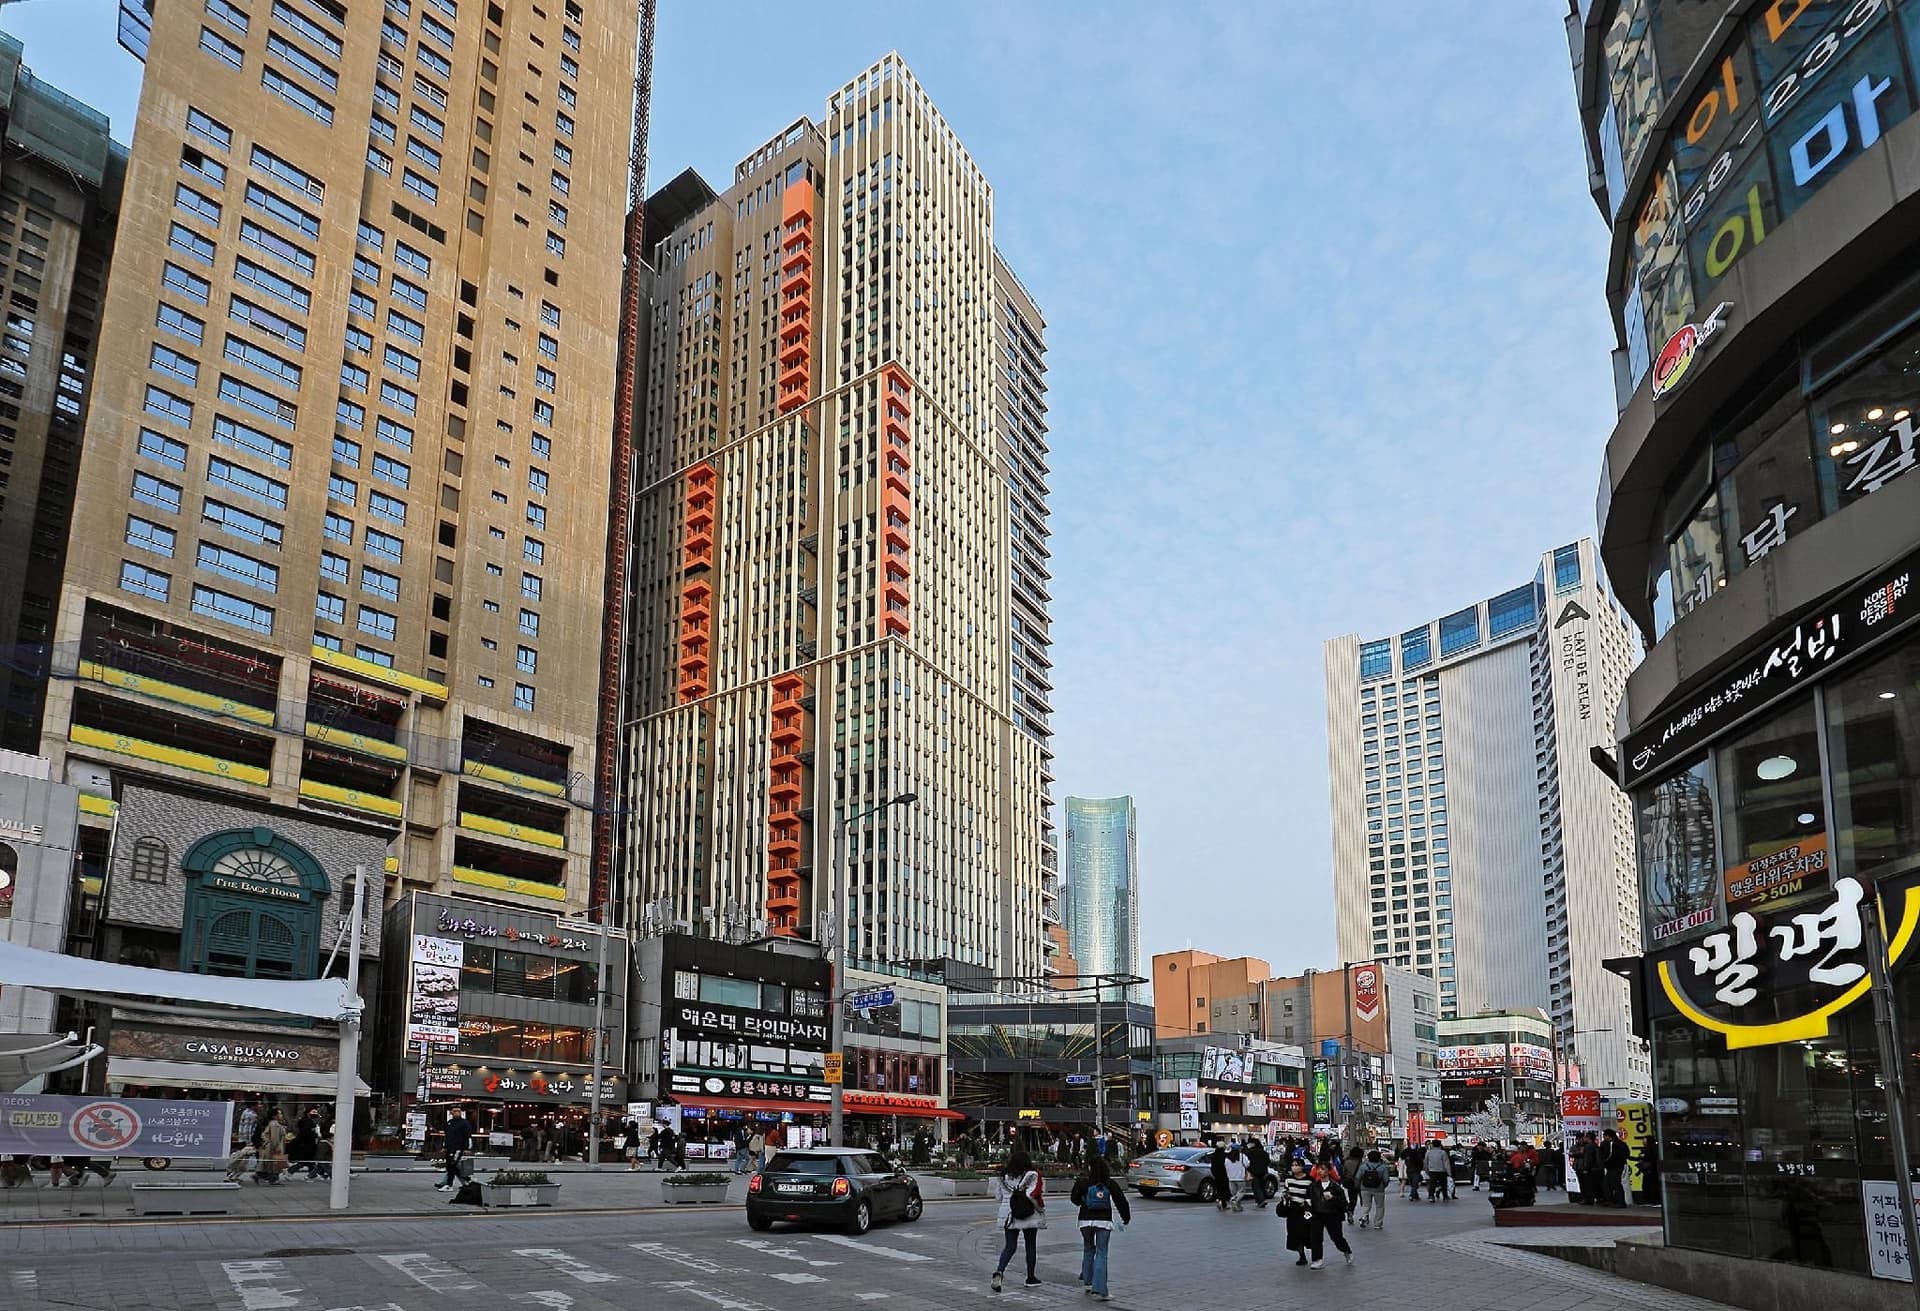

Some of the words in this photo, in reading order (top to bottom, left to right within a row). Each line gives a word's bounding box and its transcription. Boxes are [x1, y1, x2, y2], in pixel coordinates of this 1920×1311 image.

[1861, 584, 1908, 620] DESSERT
[1864, 573, 1909, 606] KOREAN
[1866, 602, 1896, 626] CAFE
[1562, 634, 1575, 672] HOTEL
[1762, 613, 1840, 678] 설빙
[1575, 662, 1588, 678] DE
[1577, 683, 1591, 720] ATLAN
[1730, 850, 1826, 898] 행운타워주차장
[1750, 847, 1800, 872] 지정주차장
[214, 878, 238, 889] THE
[241, 882, 268, 894] BACK
[270, 887, 300, 899] ROOM
[1770, 879, 1803, 899] 50M
[1654, 920, 1683, 939] TAKE
[1687, 908, 1713, 926] OUT
[1689, 877, 1868, 1007] 밀면
[681, 1008, 737, 1030] 해운대
[744, 1017, 826, 1040] 타이마사지
[185, 1042, 229, 1055] CASA
[234, 1046, 300, 1060] BUSANO
[853, 1094, 885, 1105] CAFFÈ
[888, 1097, 938, 1107] PASCUCCI
